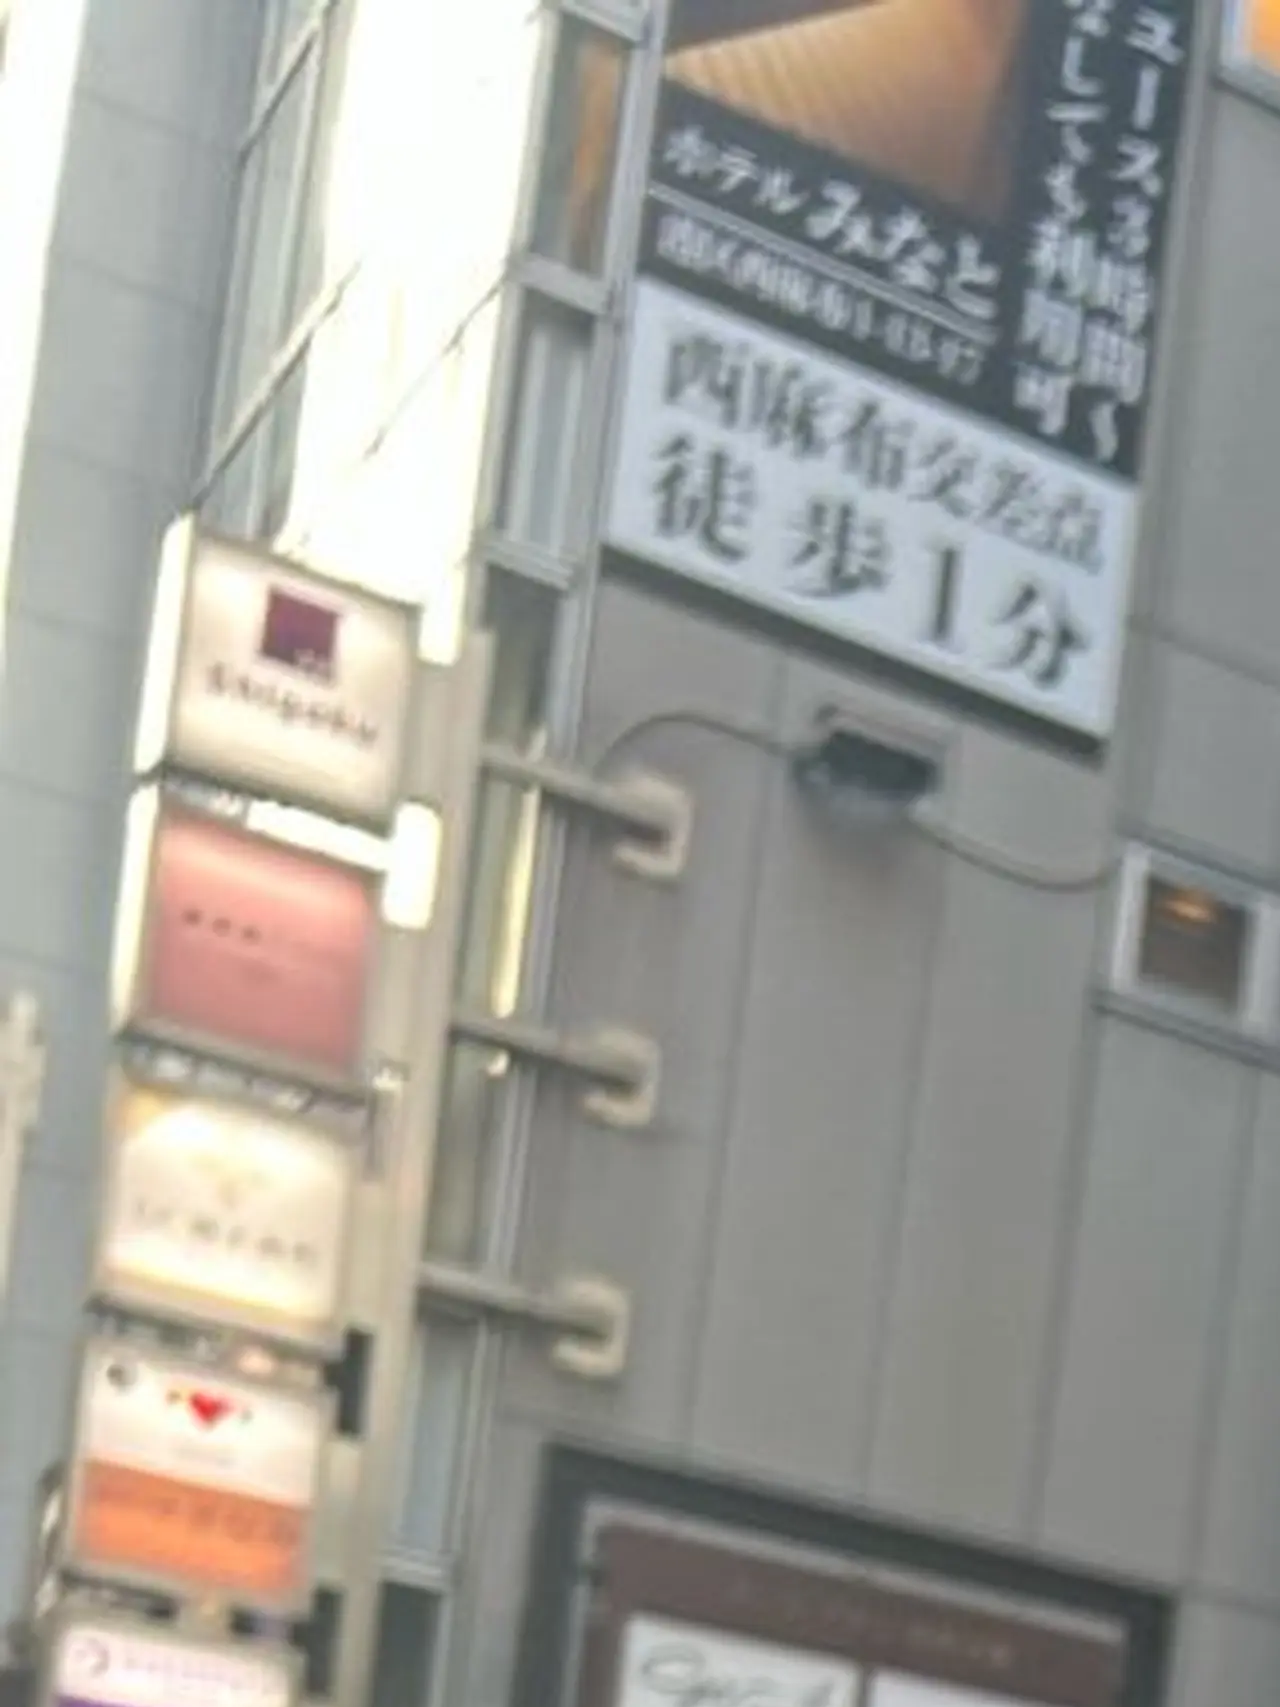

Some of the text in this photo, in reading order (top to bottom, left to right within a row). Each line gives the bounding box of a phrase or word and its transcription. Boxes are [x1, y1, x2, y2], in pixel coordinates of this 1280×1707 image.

[667, 334, 1104, 577] 西麻布交差点
